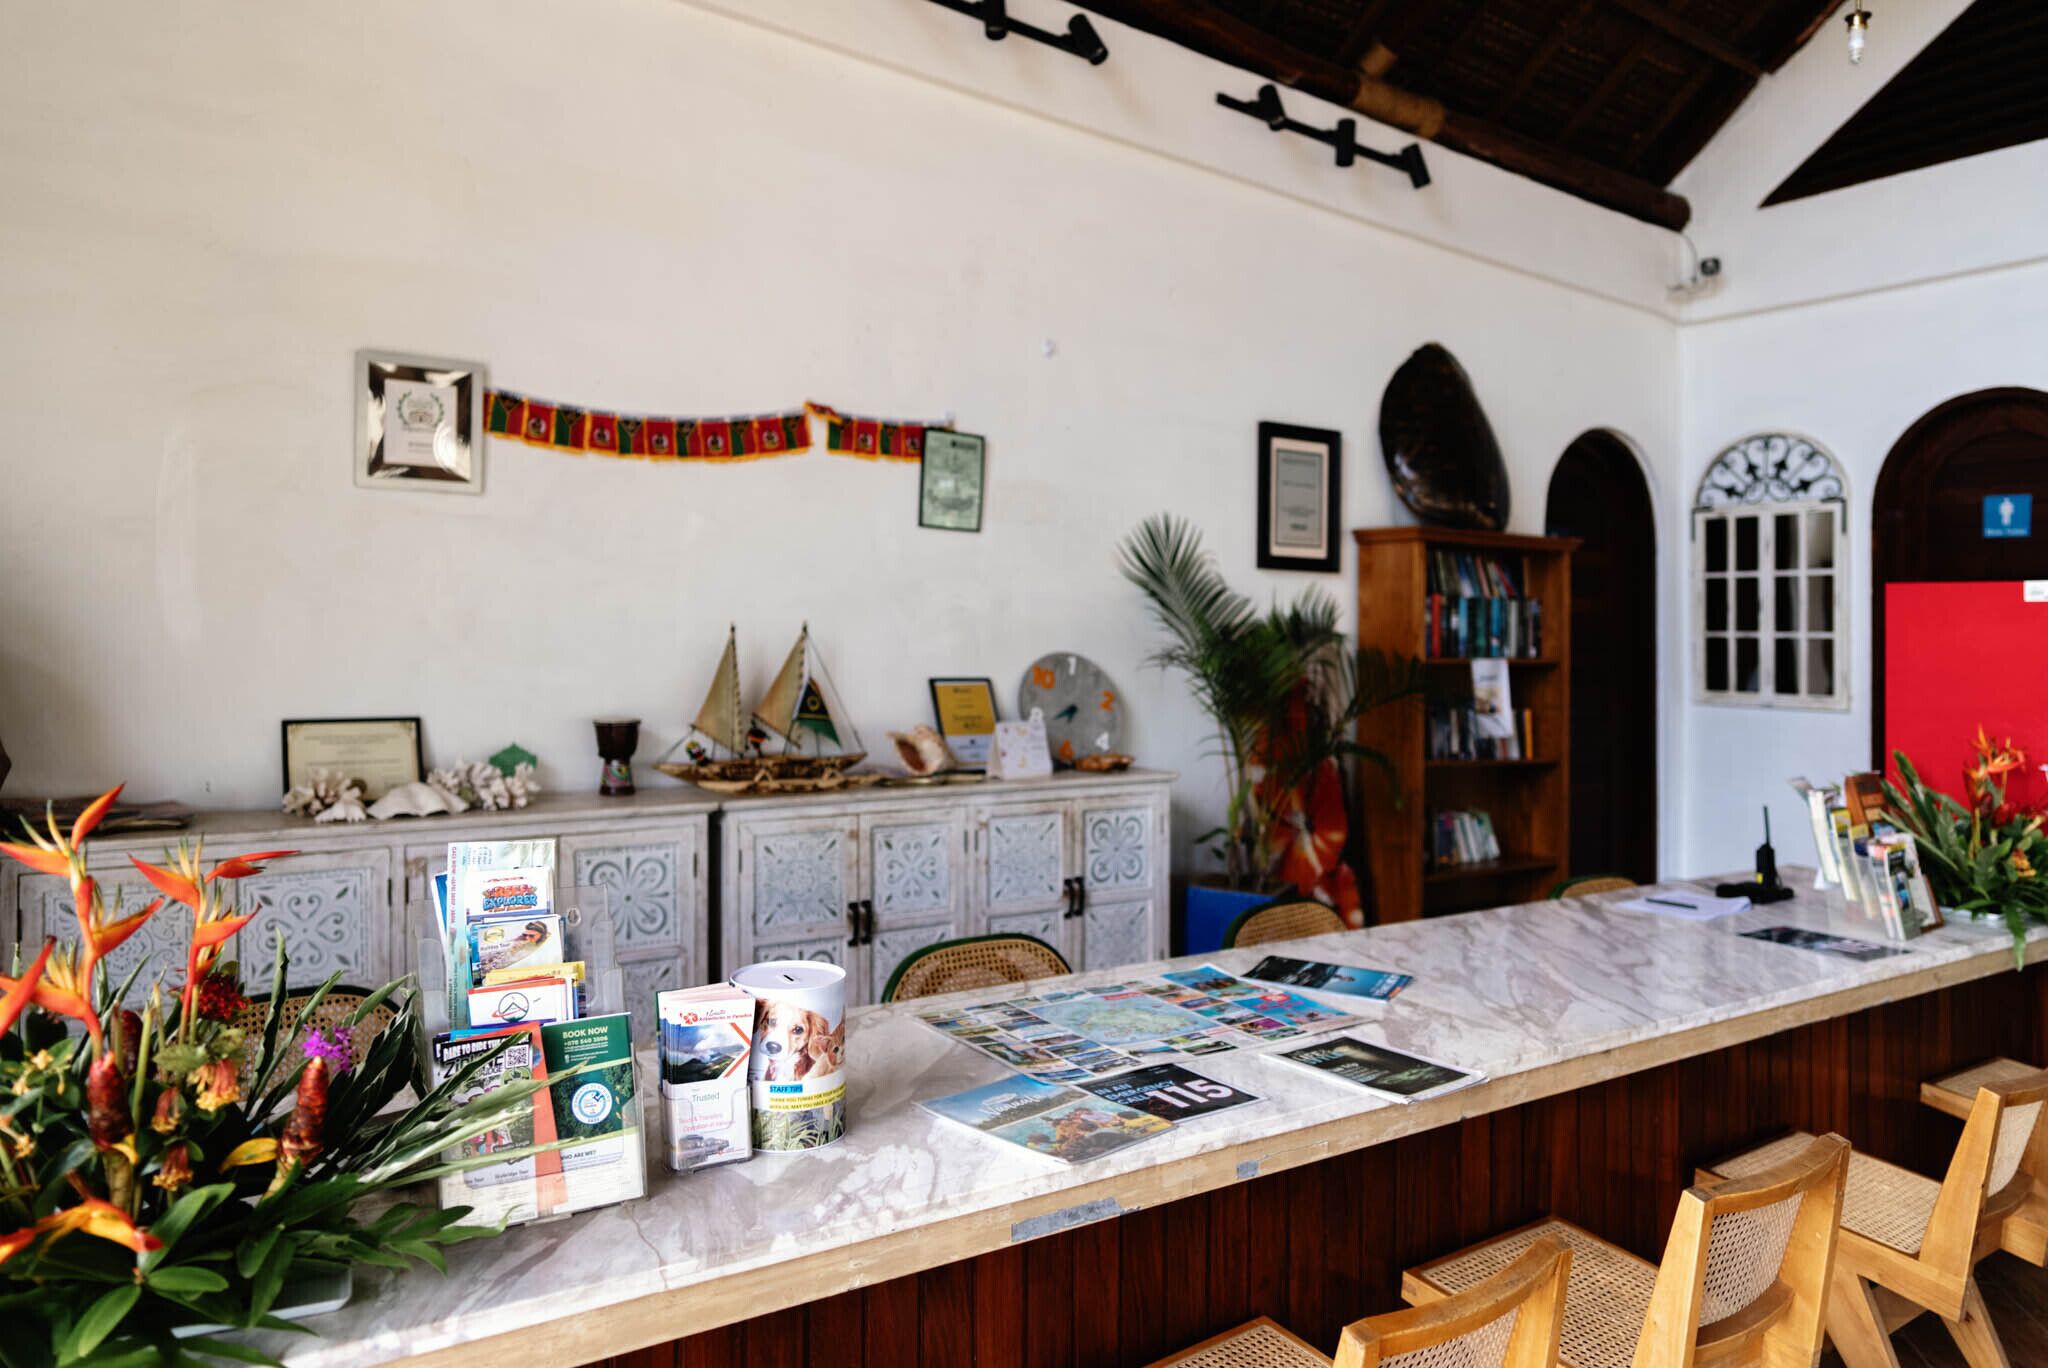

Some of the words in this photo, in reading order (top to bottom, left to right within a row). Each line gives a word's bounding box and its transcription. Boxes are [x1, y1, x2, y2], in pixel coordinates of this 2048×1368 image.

[483, 893, 538, 911] EXPLORER
[562, 1028, 587, 1039] BOOK
[587, 1026, 608, 1035] NOW
[443, 1045, 461, 1062] DARE
[461, 1043, 471, 1056] TO
[770, 1085, 788, 1093] STAFF
[790, 1085, 803, 1093] TIPS
[1094, 1087, 1112, 1095] IN
[1112, 1083, 1132, 1092] AN
[1105, 1080, 1175, 1100] EMERGENCY
[1144, 1079, 1233, 1108] 115
[692, 1092, 720, 1102] Trusted
[1117, 1094, 1151, 1105] CALL
